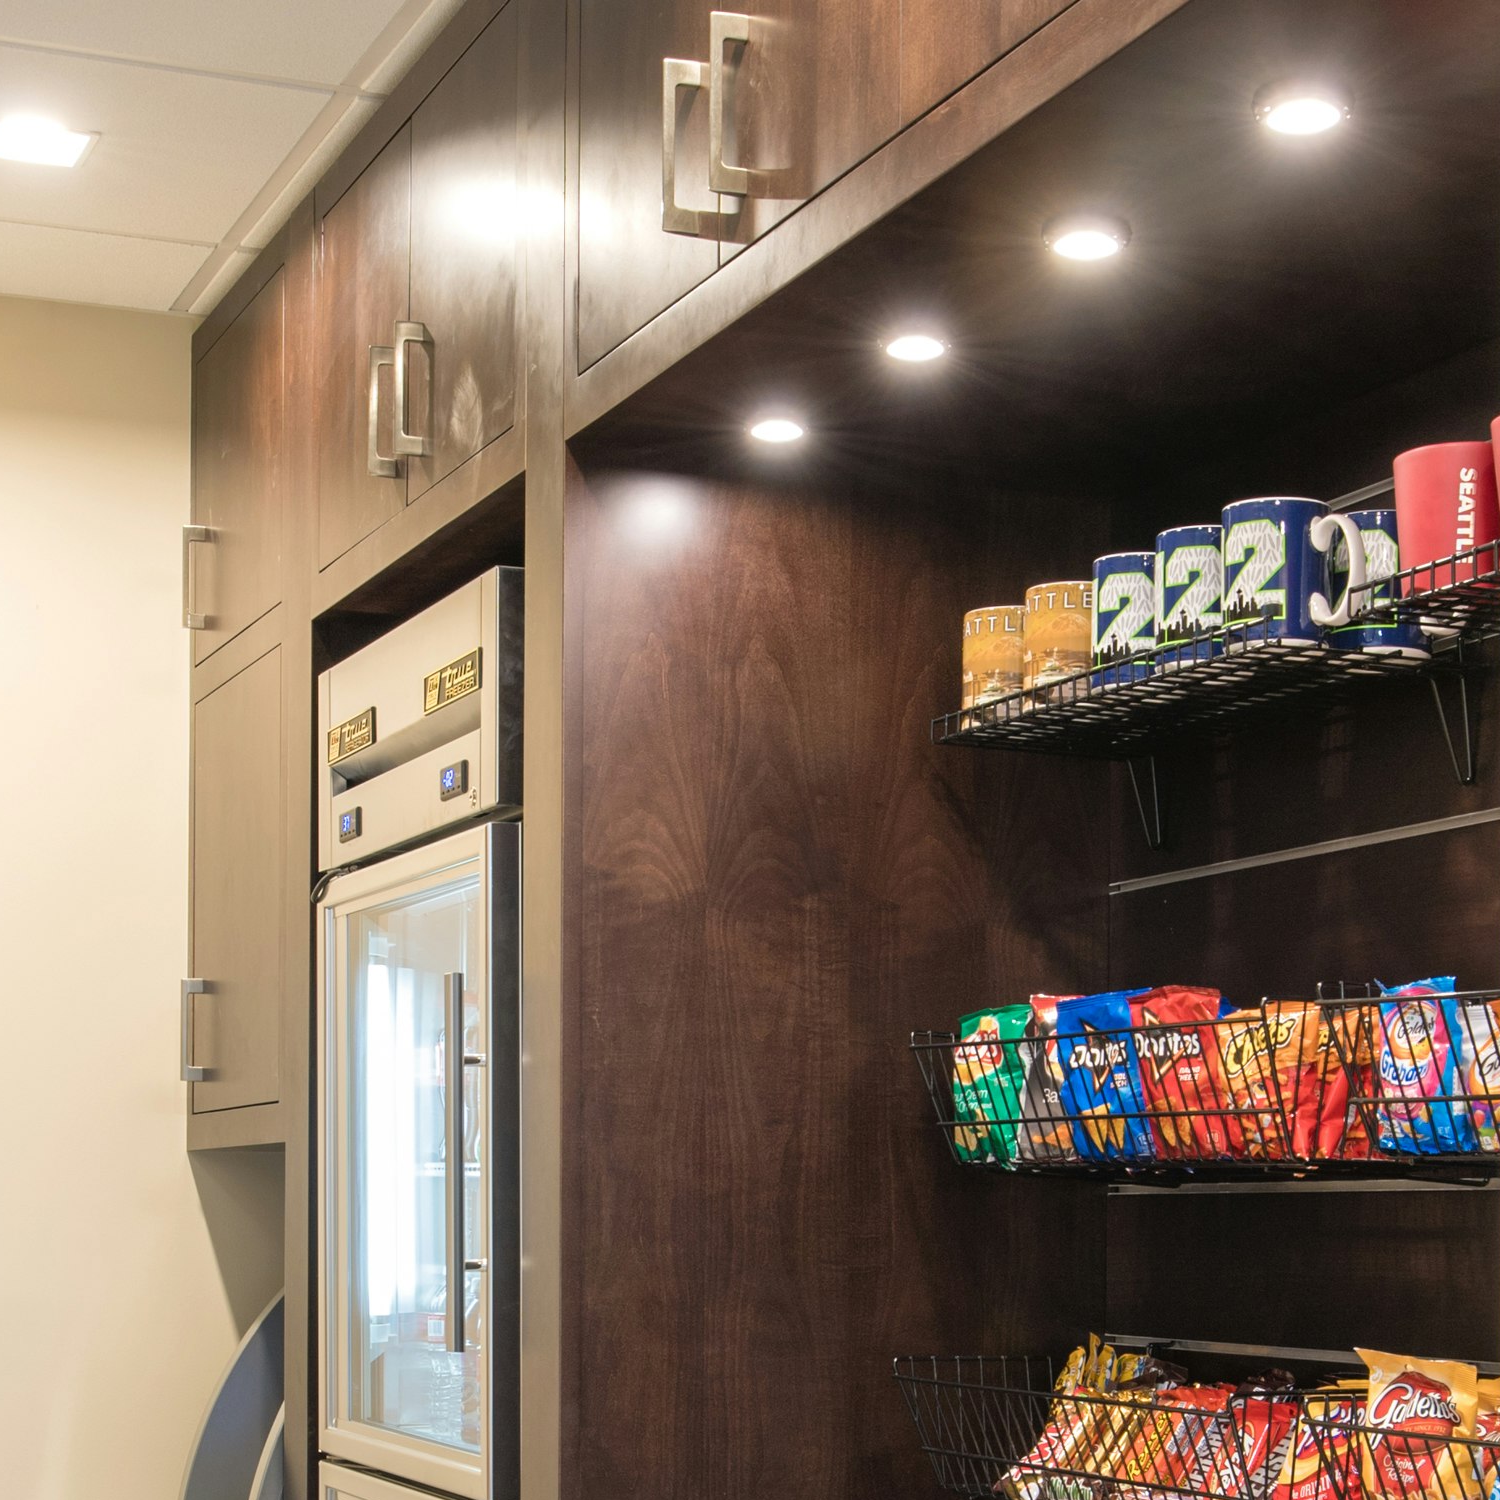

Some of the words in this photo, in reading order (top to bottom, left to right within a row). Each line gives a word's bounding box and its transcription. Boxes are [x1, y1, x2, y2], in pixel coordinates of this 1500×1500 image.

[1026, 592, 1093, 614] ATTLE
[963, 616, 1025, 639] ATTL
[445, 677, 475, 700] FREEZER
[1135, 1031, 1200, 1058] Doritos
